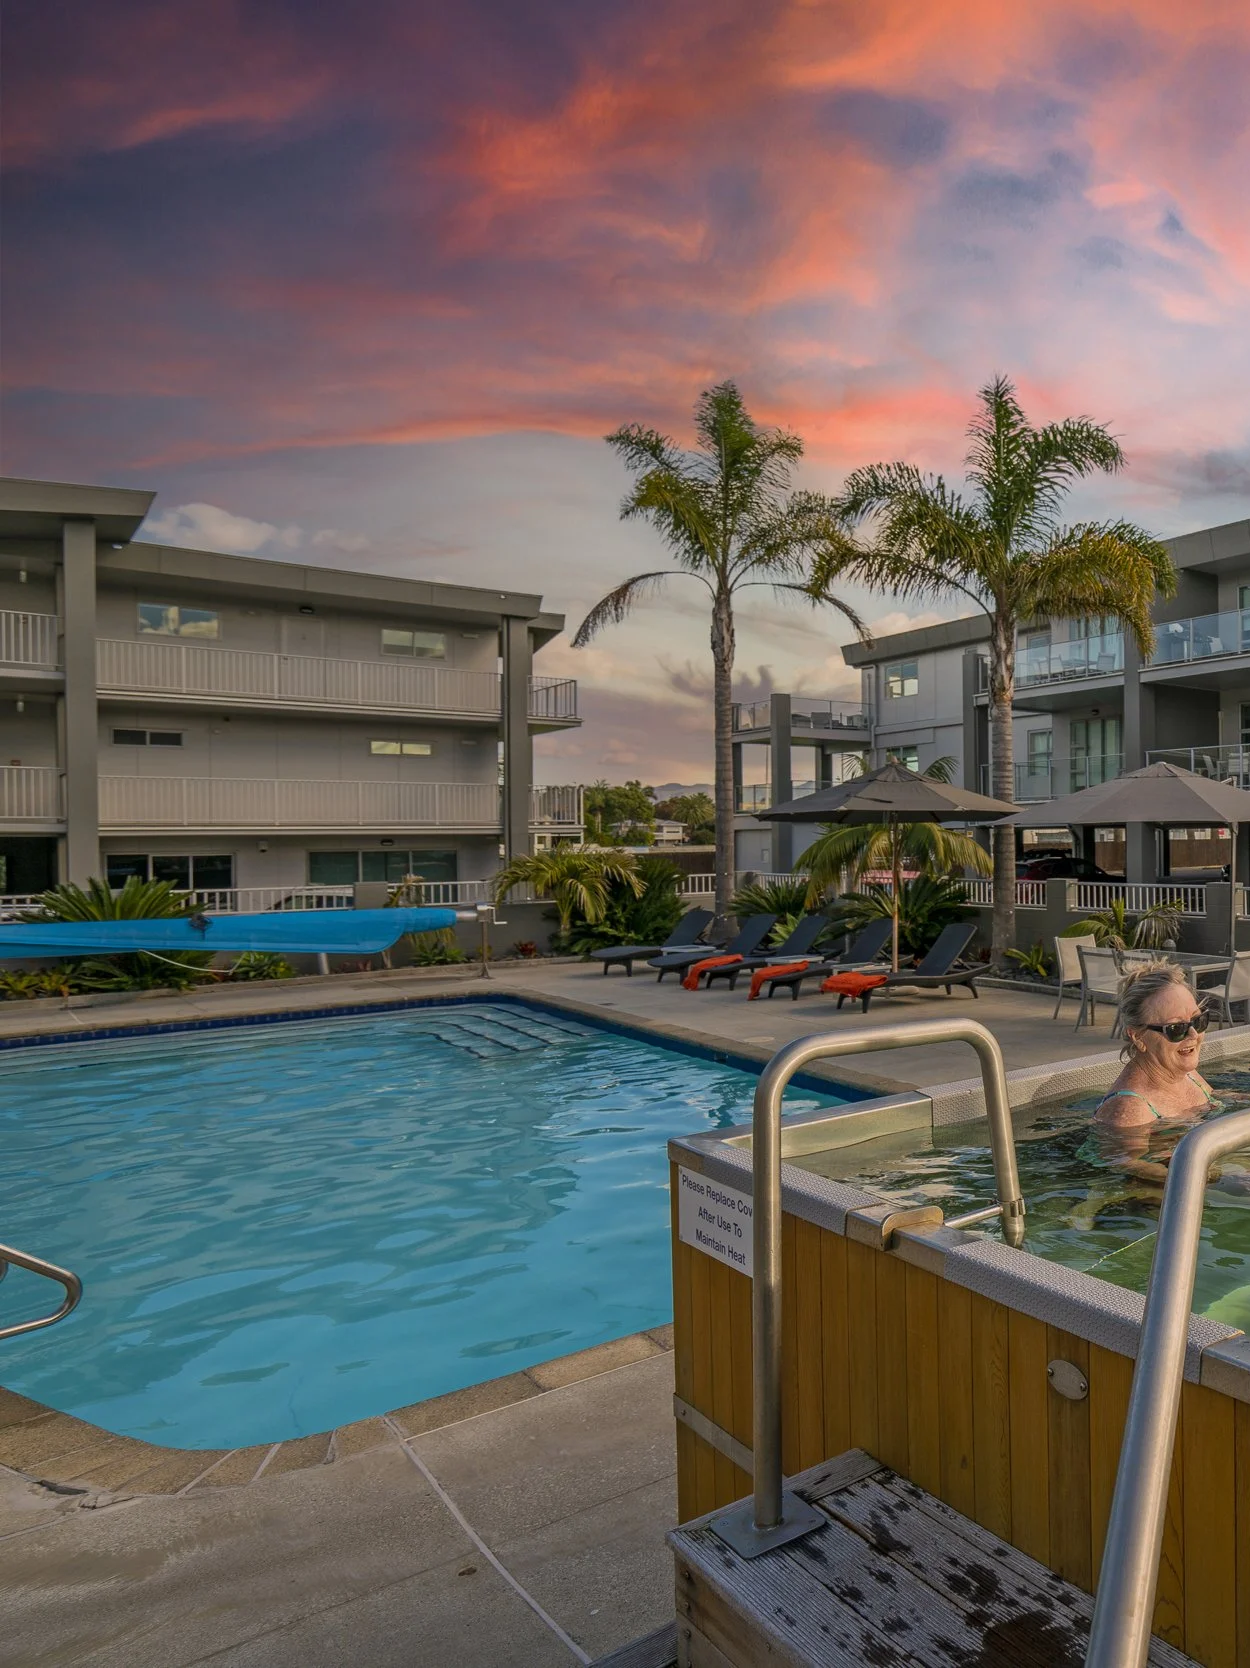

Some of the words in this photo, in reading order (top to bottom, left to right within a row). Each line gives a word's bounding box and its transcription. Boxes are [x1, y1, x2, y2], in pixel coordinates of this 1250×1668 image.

[681, 1174, 705, 1195] Please
[706, 1184, 736, 1210] Replace
[737, 1199, 753, 1218] Cov
[698, 1206, 715, 1225] After
[716, 1214, 732, 1233] Use
[733, 1222, 743, 1239] To
[695, 1228, 727, 1255] Maintain
[727, 1244, 746, 1266] Heat
